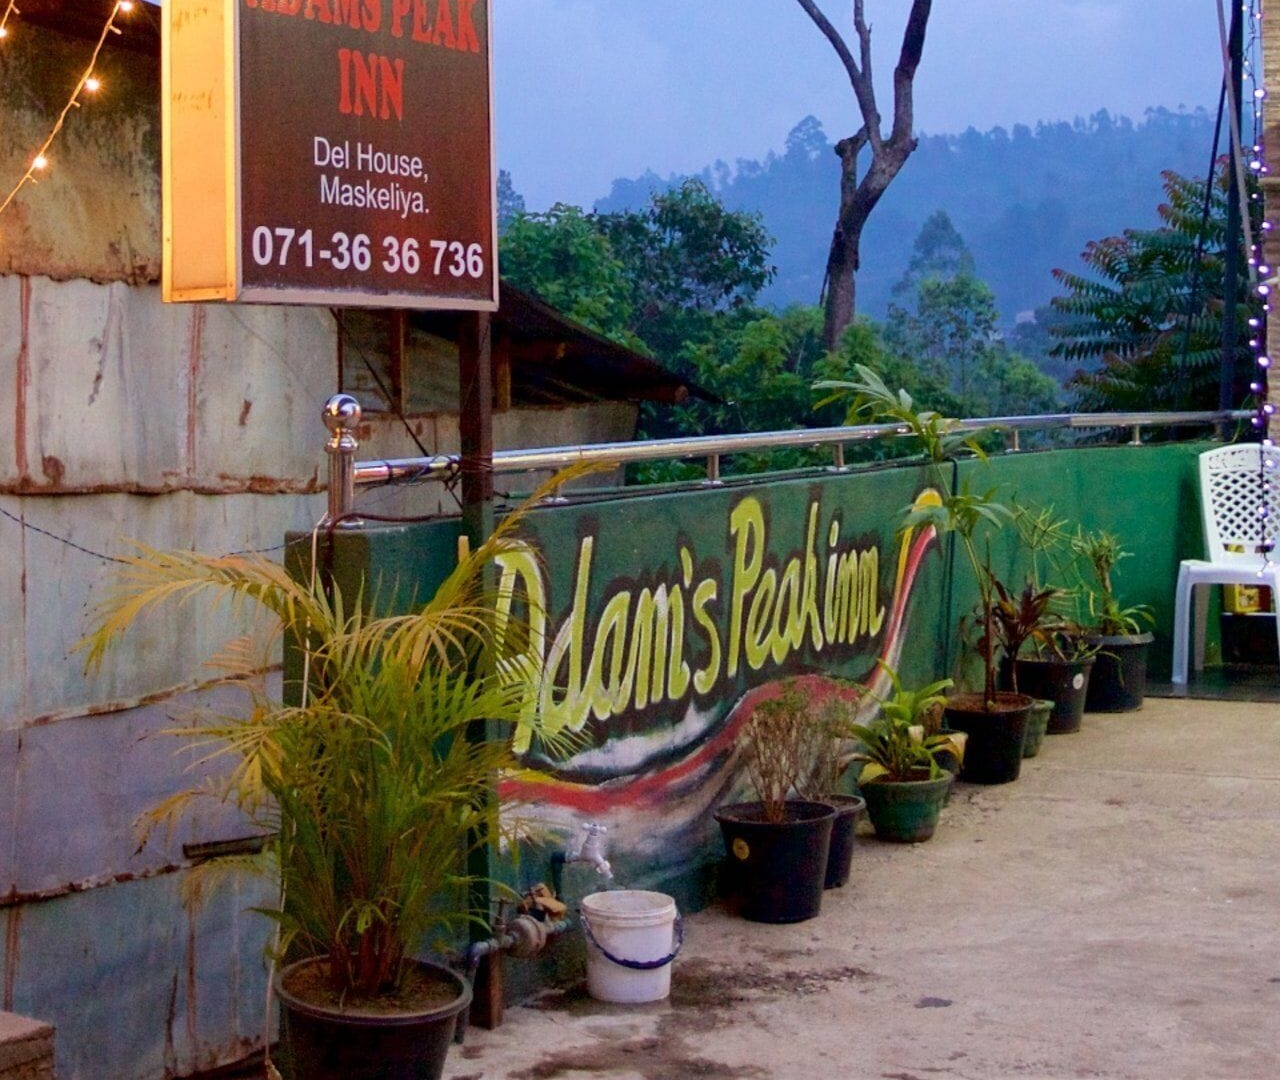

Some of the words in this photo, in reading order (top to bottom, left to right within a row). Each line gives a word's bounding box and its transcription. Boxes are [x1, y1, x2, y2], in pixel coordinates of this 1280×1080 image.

[338, 48, 406, 121] INN
[313, 136, 349, 170] Del
[357, 142, 429, 182] House,
[320, 174, 430, 219] Maskeliya.
[252, 225, 371, 271] 071-36
[382, 235, 420, 274] 36
[430, 240, 484, 278] 736
